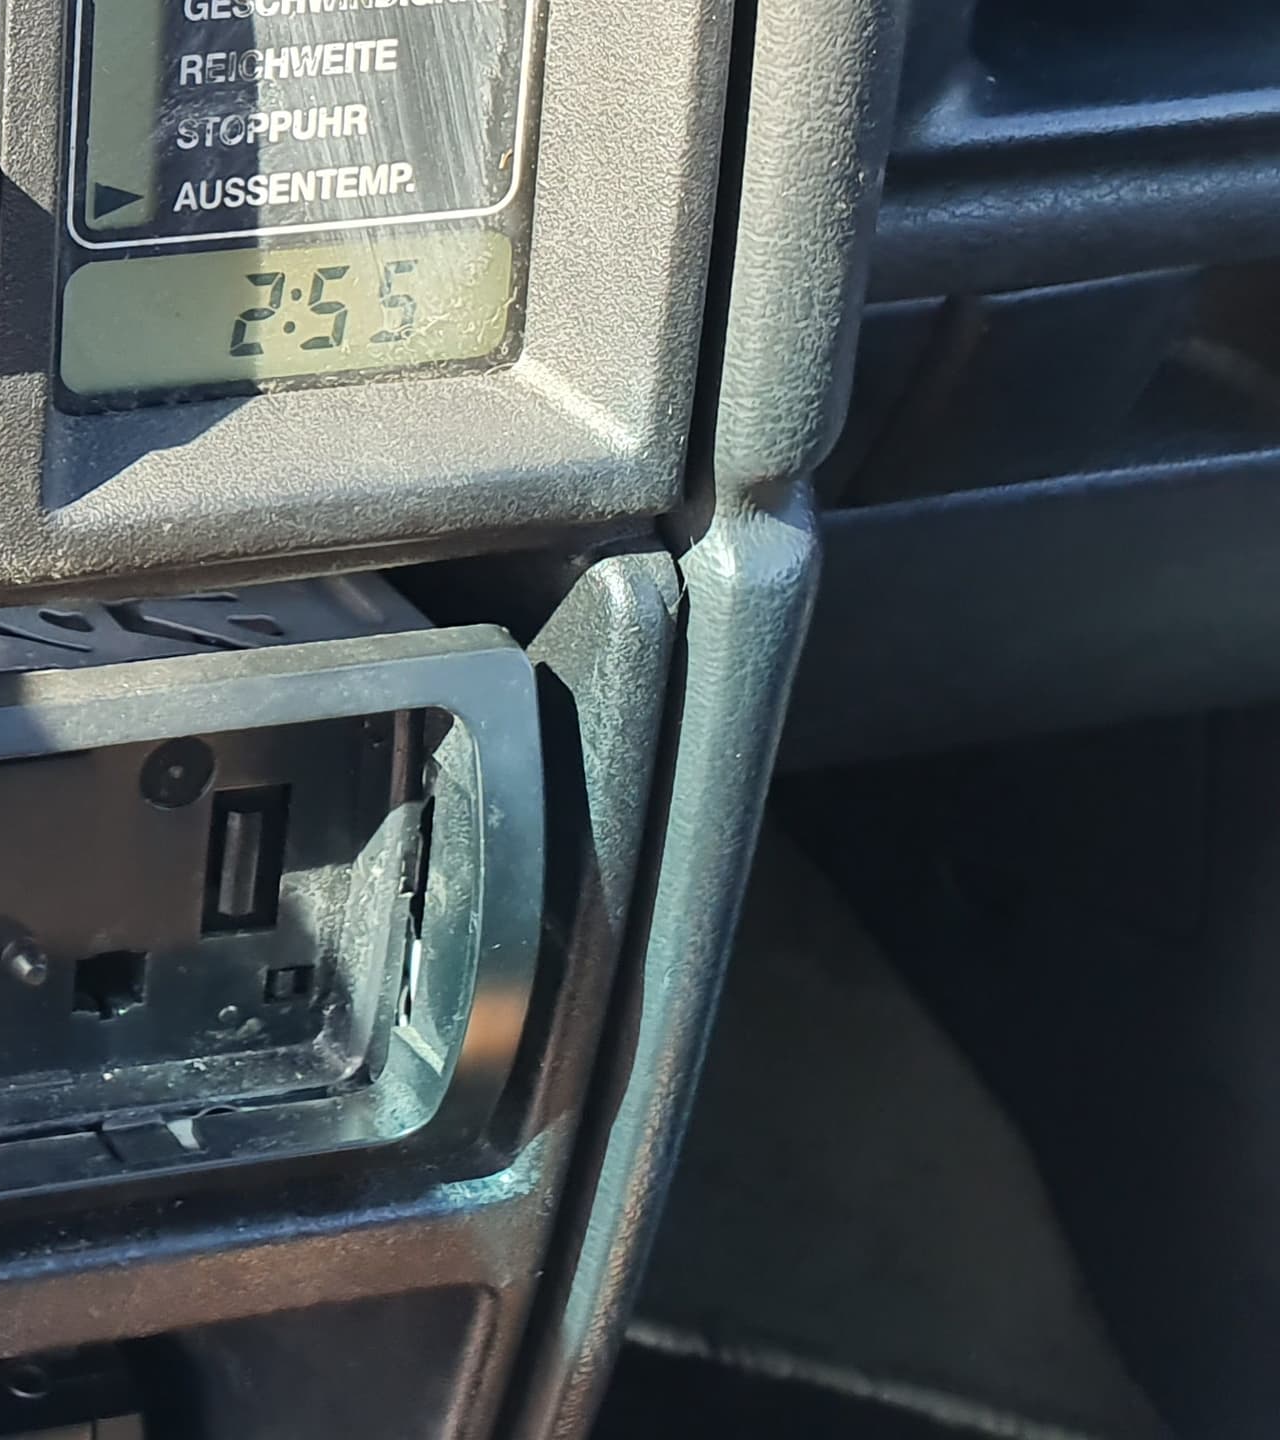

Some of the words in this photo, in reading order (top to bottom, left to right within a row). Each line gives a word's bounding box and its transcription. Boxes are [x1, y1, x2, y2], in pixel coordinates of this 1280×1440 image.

[179, 38, 399, 86] REICHWEITE
[175, 104, 368, 150] STOPPUHR
[174, 162, 416, 213] AUSSENTEMP.
[229, 259, 419, 357] 2:55
